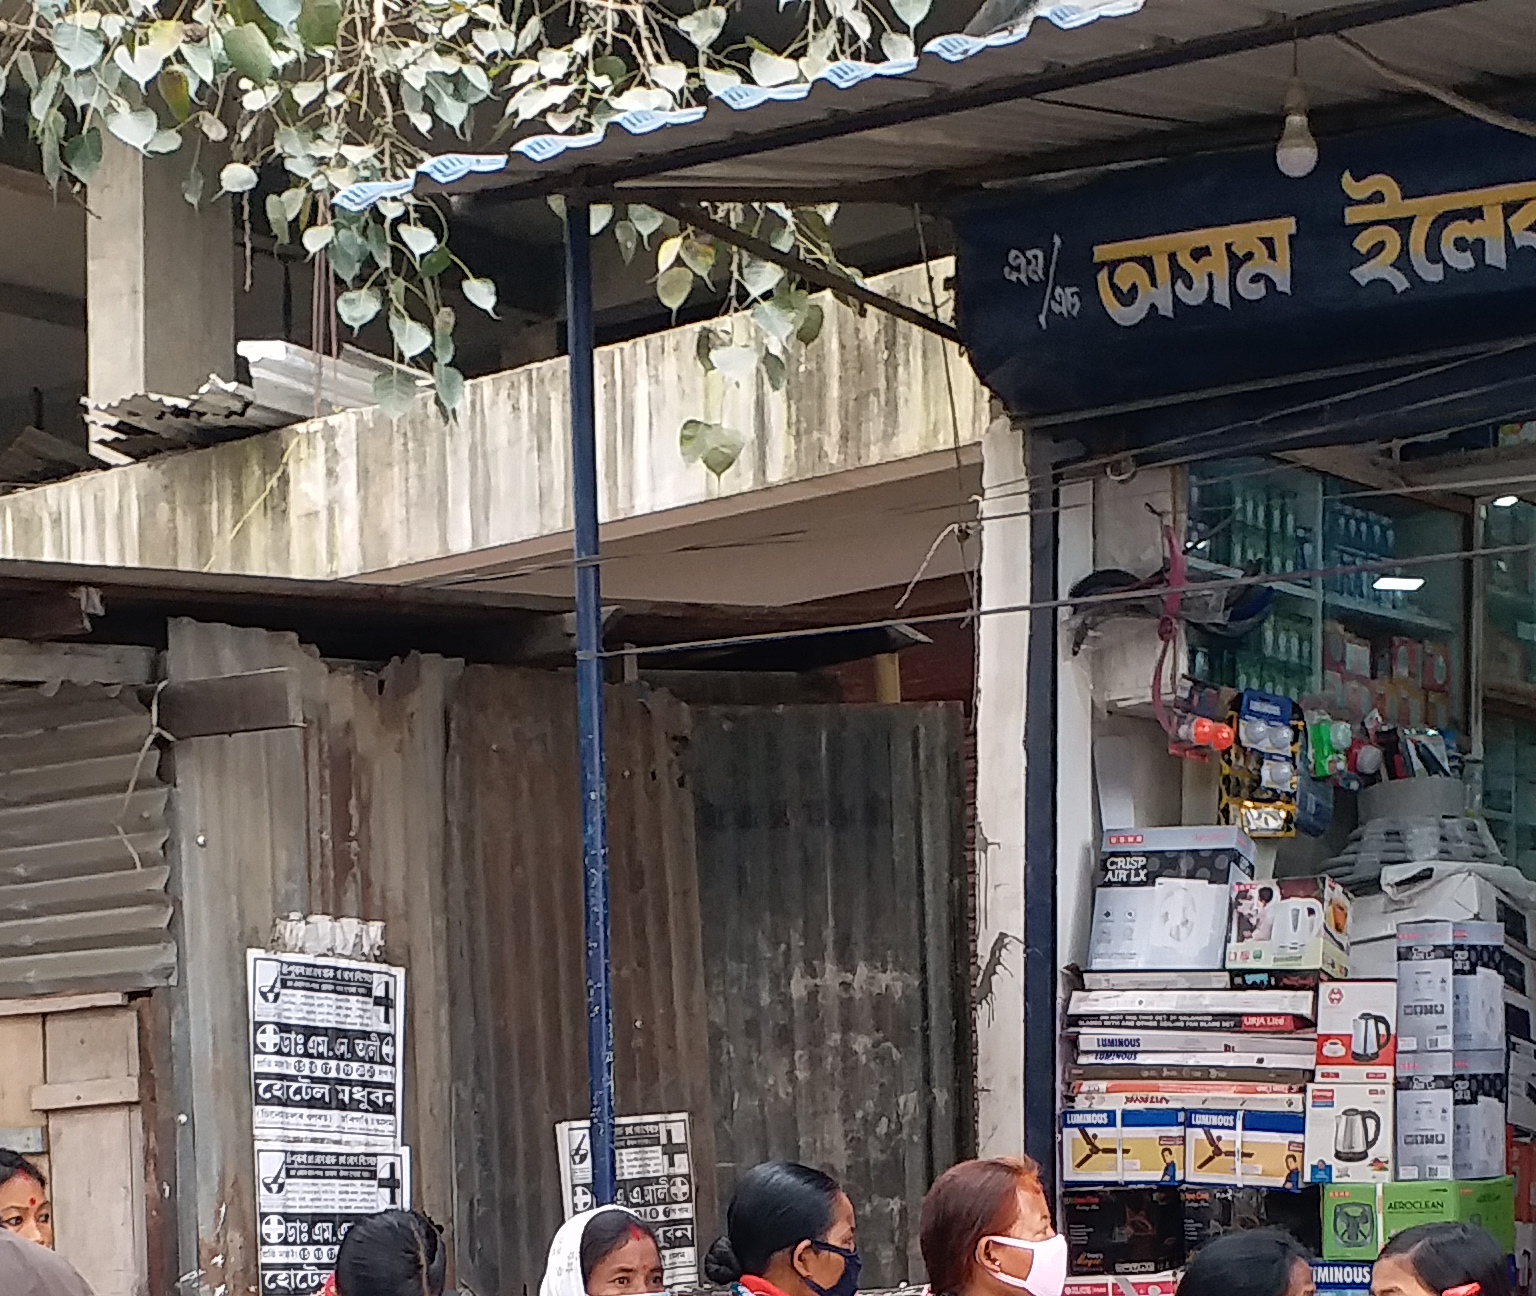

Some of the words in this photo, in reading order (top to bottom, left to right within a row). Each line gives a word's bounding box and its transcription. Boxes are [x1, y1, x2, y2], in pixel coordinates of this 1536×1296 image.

[1093, 215, 1297, 327] অসম
[1106, 856, 1147, 870] CRISP
[1104, 869, 1130, 882] AIR
[1131, 869, 1148, 882] LX
[255, 1075, 331, 1104] হোটেল
[1066, 1112, 1109, 1125] LUMINOUS
[1191, 1112, 1235, 1127] LUMINOUS
[1387, 1200, 1445, 1211] AEROCLEAN
[1313, 1266, 1371, 1284] MINOUS
